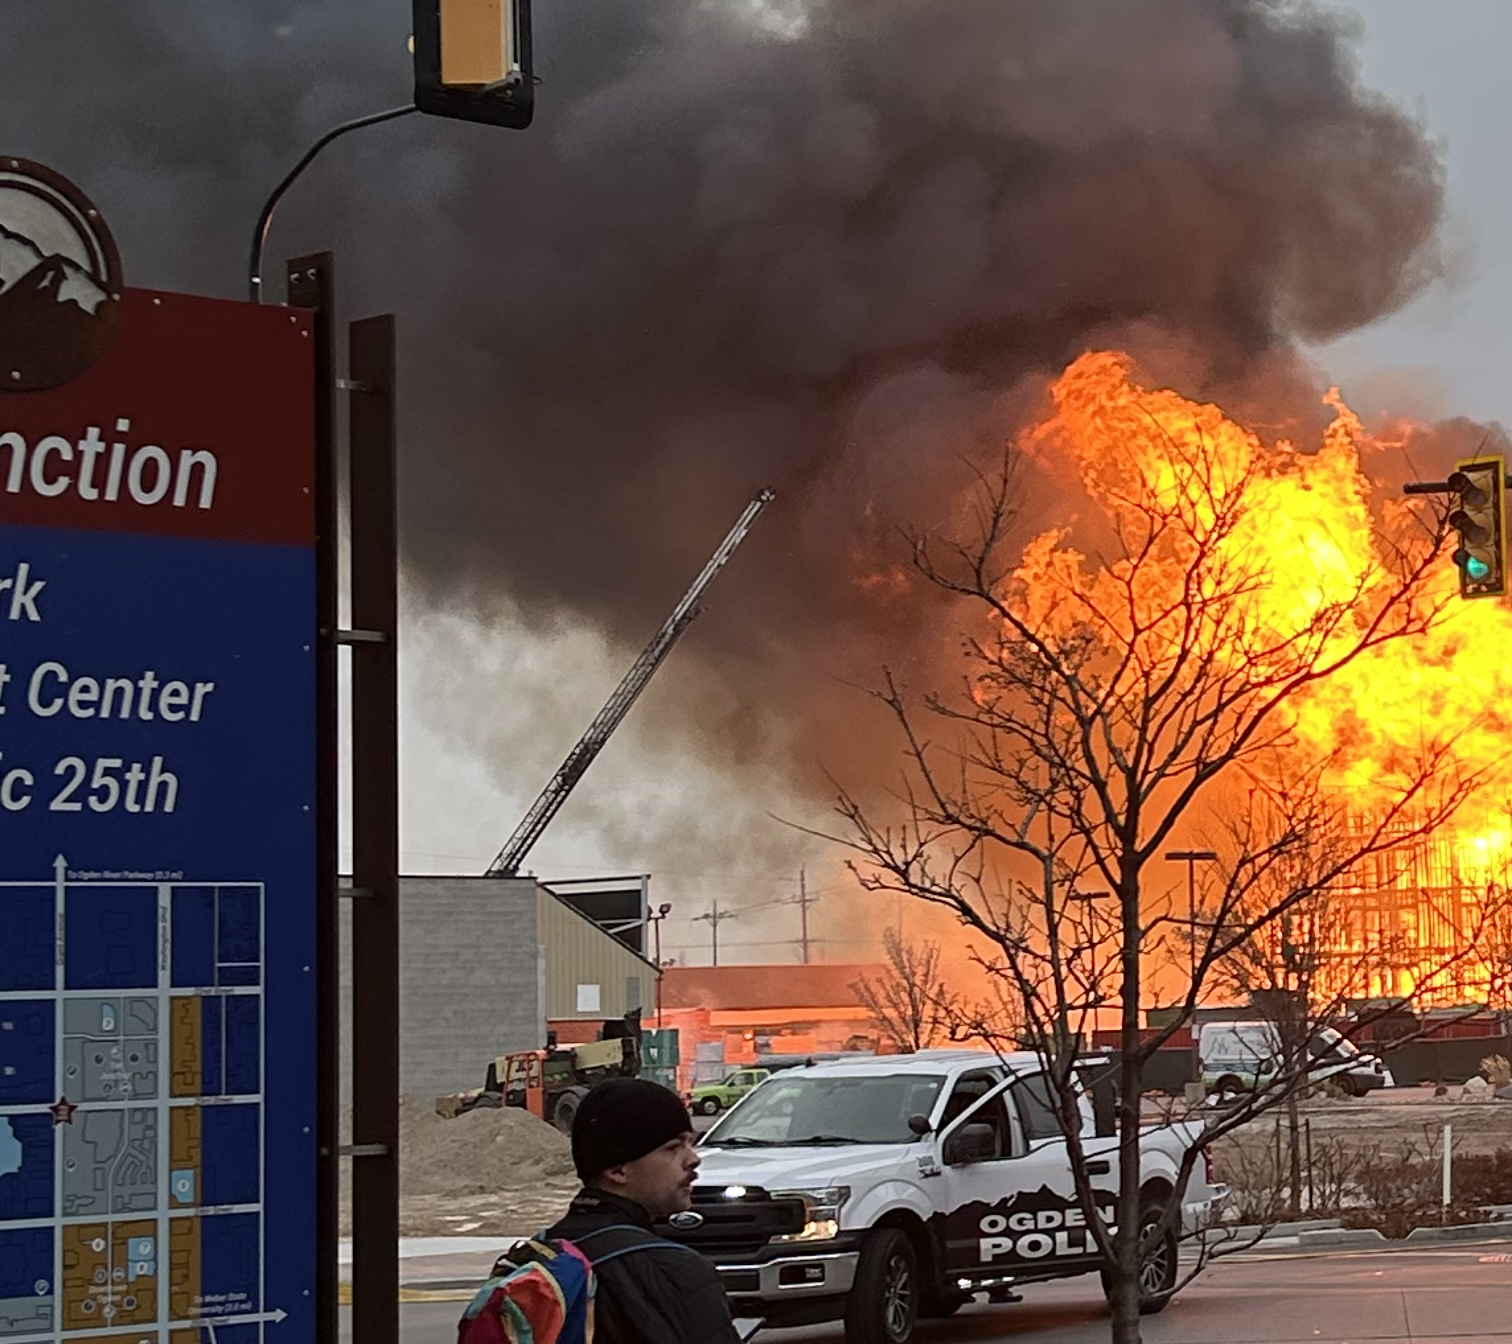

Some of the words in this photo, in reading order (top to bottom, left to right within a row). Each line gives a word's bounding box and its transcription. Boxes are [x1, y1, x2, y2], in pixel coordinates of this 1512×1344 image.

[0, 418, 217, 509] nction
[0, 562, 47, 622] k
[28, 661, 215, 723] Center
[0, 750, 34, 812] c
[49, 755, 178, 813] 25th
[979, 1204, 1116, 1234] OGDEN
[979, 1226, 1119, 1263] POLI
